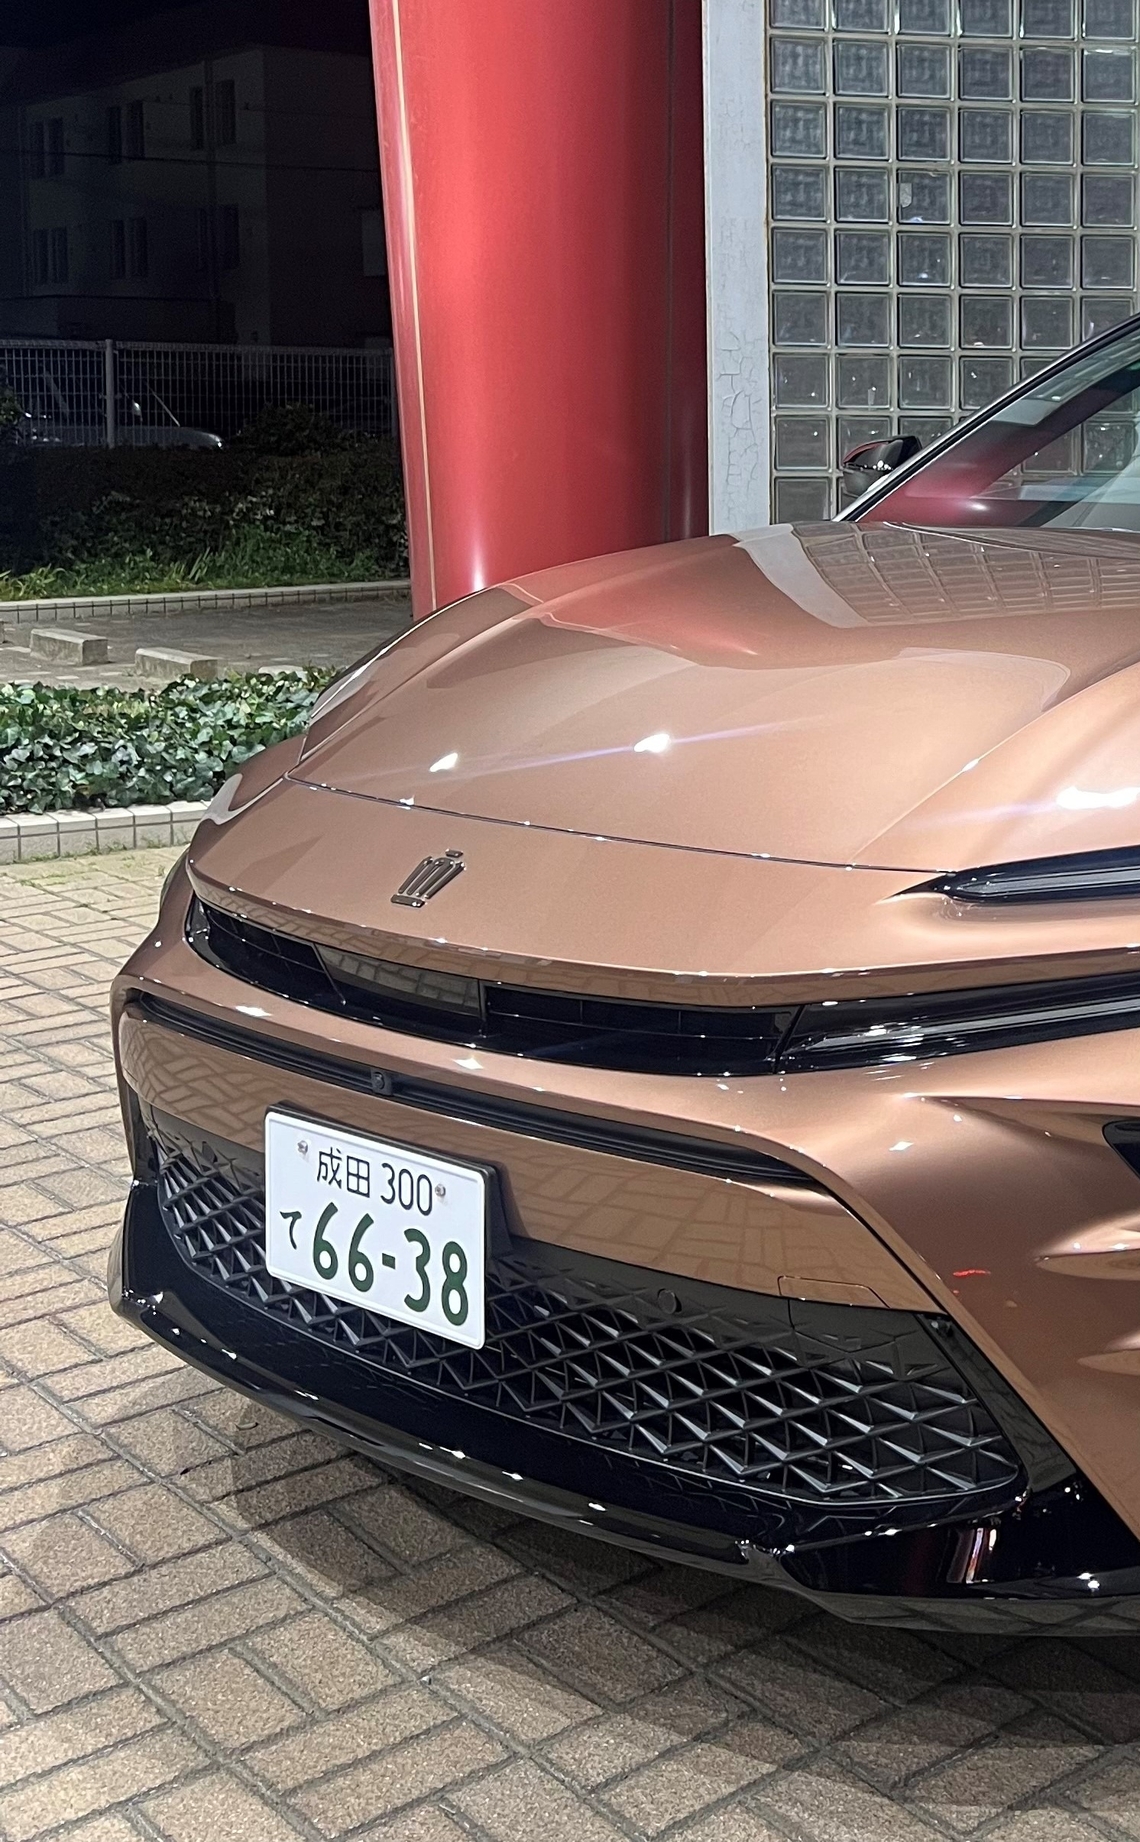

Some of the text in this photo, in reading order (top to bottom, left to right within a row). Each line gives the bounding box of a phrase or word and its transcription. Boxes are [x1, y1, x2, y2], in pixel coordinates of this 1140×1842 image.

[317, 1146, 433, 1216] 成田 300
[279, 1202, 468, 1326] て 66-38
